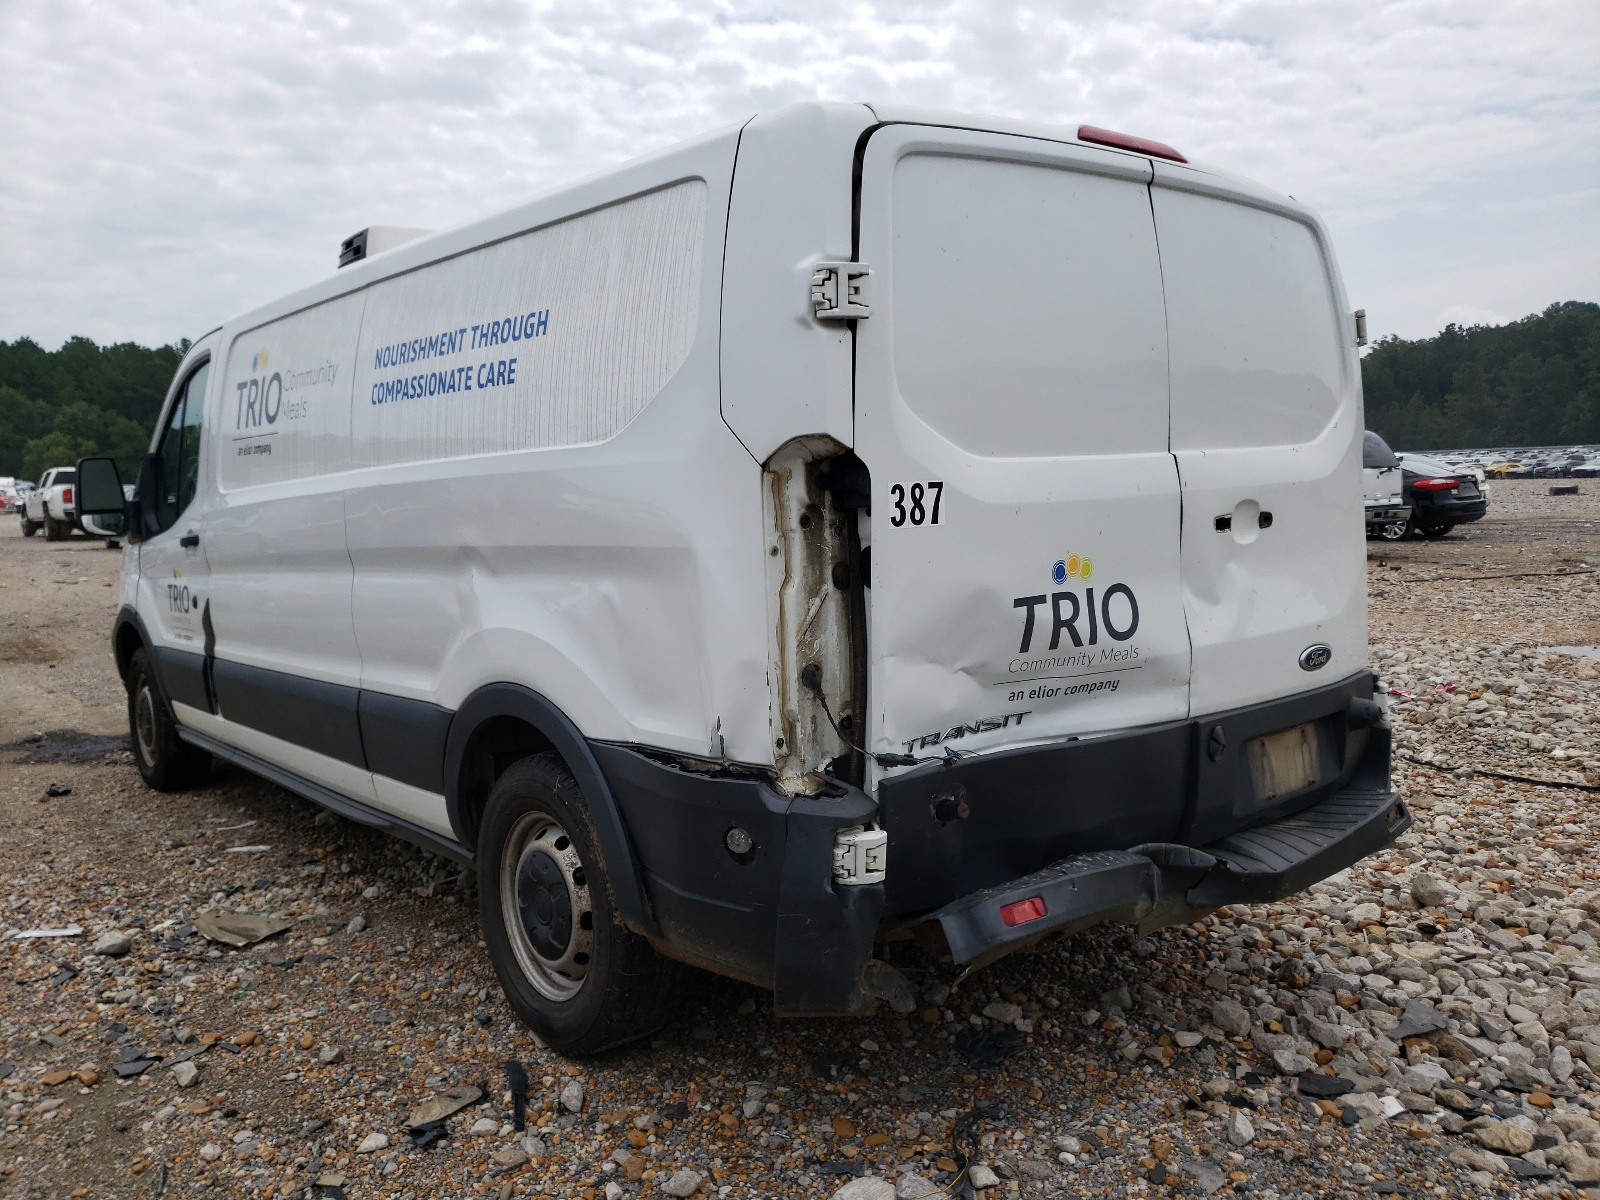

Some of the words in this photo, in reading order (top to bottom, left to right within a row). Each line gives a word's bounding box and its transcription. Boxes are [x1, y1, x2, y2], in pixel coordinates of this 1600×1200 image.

[374, 328, 468, 370] NOURISHMENT
[471, 309, 549, 350] THROUGH
[284, 360, 339, 392] Community
[371, 364, 473, 406] COMPASSIONATE
[477, 358, 518, 389] CARE
[236, 372, 283, 430] TRIO
[282, 396, 308, 422] Meals
[890, 481, 944, 527] 387
[167, 584, 190, 614] TRIO
[1013, 582, 1140, 654] TRIO
[1008, 650, 1096, 674] Community
[1100, 645, 1139, 663] Meals
[1008, 689, 1024, 702] an
[1028, 684, 1061, 700] elior
[1063, 678, 1120, 698] company
[901, 711, 1032, 753] TRANSIT
